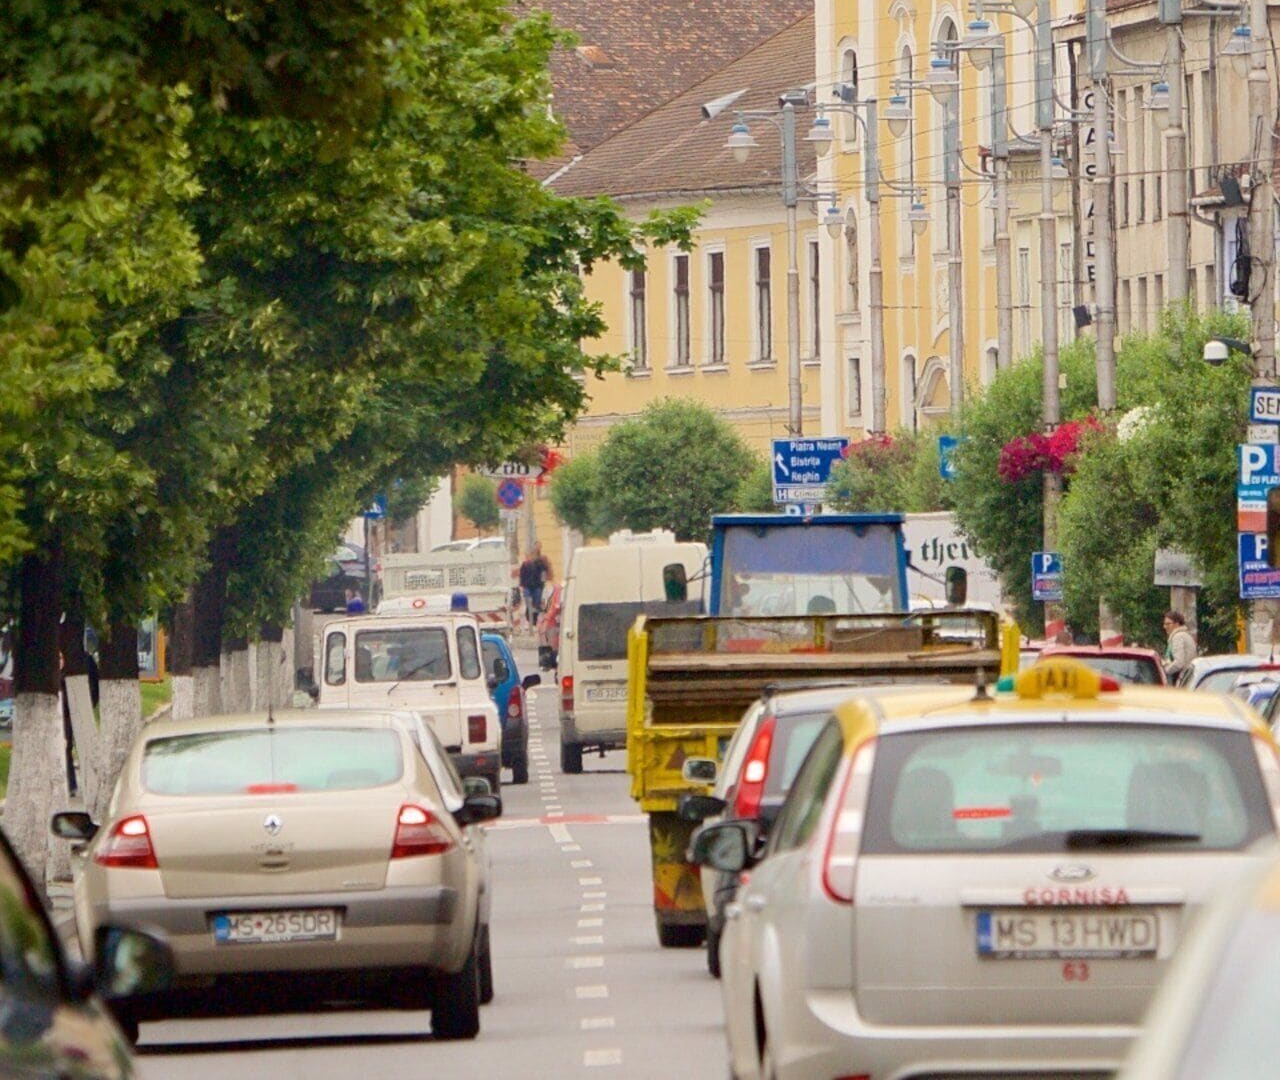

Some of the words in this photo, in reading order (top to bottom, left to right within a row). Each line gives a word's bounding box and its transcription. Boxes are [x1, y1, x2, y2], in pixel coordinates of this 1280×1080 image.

[790, 442, 815, 451] Piatra
[1241, 445, 1268, 486] P
[791, 472, 820, 483] Reghin
[1042, 554, 1053, 573] P
[1036, 666, 1078, 691] TAXI
[1023, 887, 1129, 904] CORNISA
[230, 914, 253, 935] MS
[997, 920, 1036, 946] MS
[1062, 961, 1089, 981] 63
